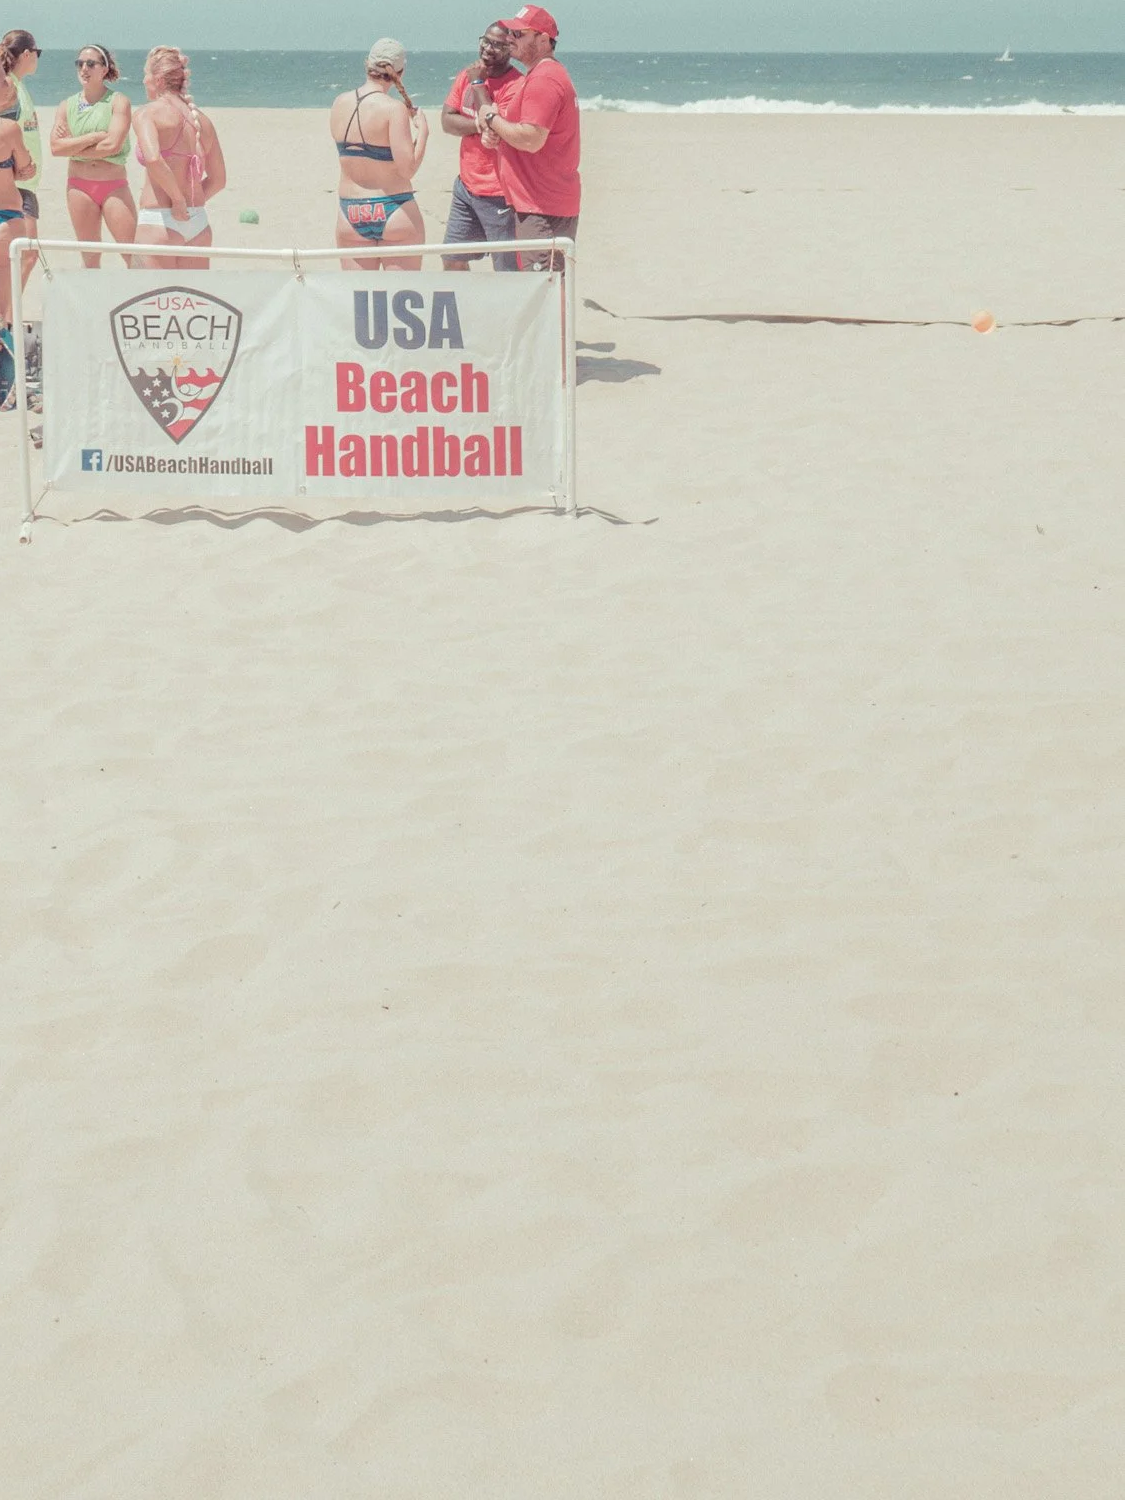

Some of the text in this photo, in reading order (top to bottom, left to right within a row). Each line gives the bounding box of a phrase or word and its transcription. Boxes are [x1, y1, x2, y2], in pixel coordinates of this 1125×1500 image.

[348, 203, 386, 223] USA
[157, 297, 195, 311] USA
[120, 314, 232, 341] BEACH
[353, 289, 465, 350] USA
[123, 341, 228, 350] HANDBALL
[336, 362, 489, 414] Beach
[305, 425, 523, 477] Handball
[106, 454, 273, 475] /USABeachHandball
